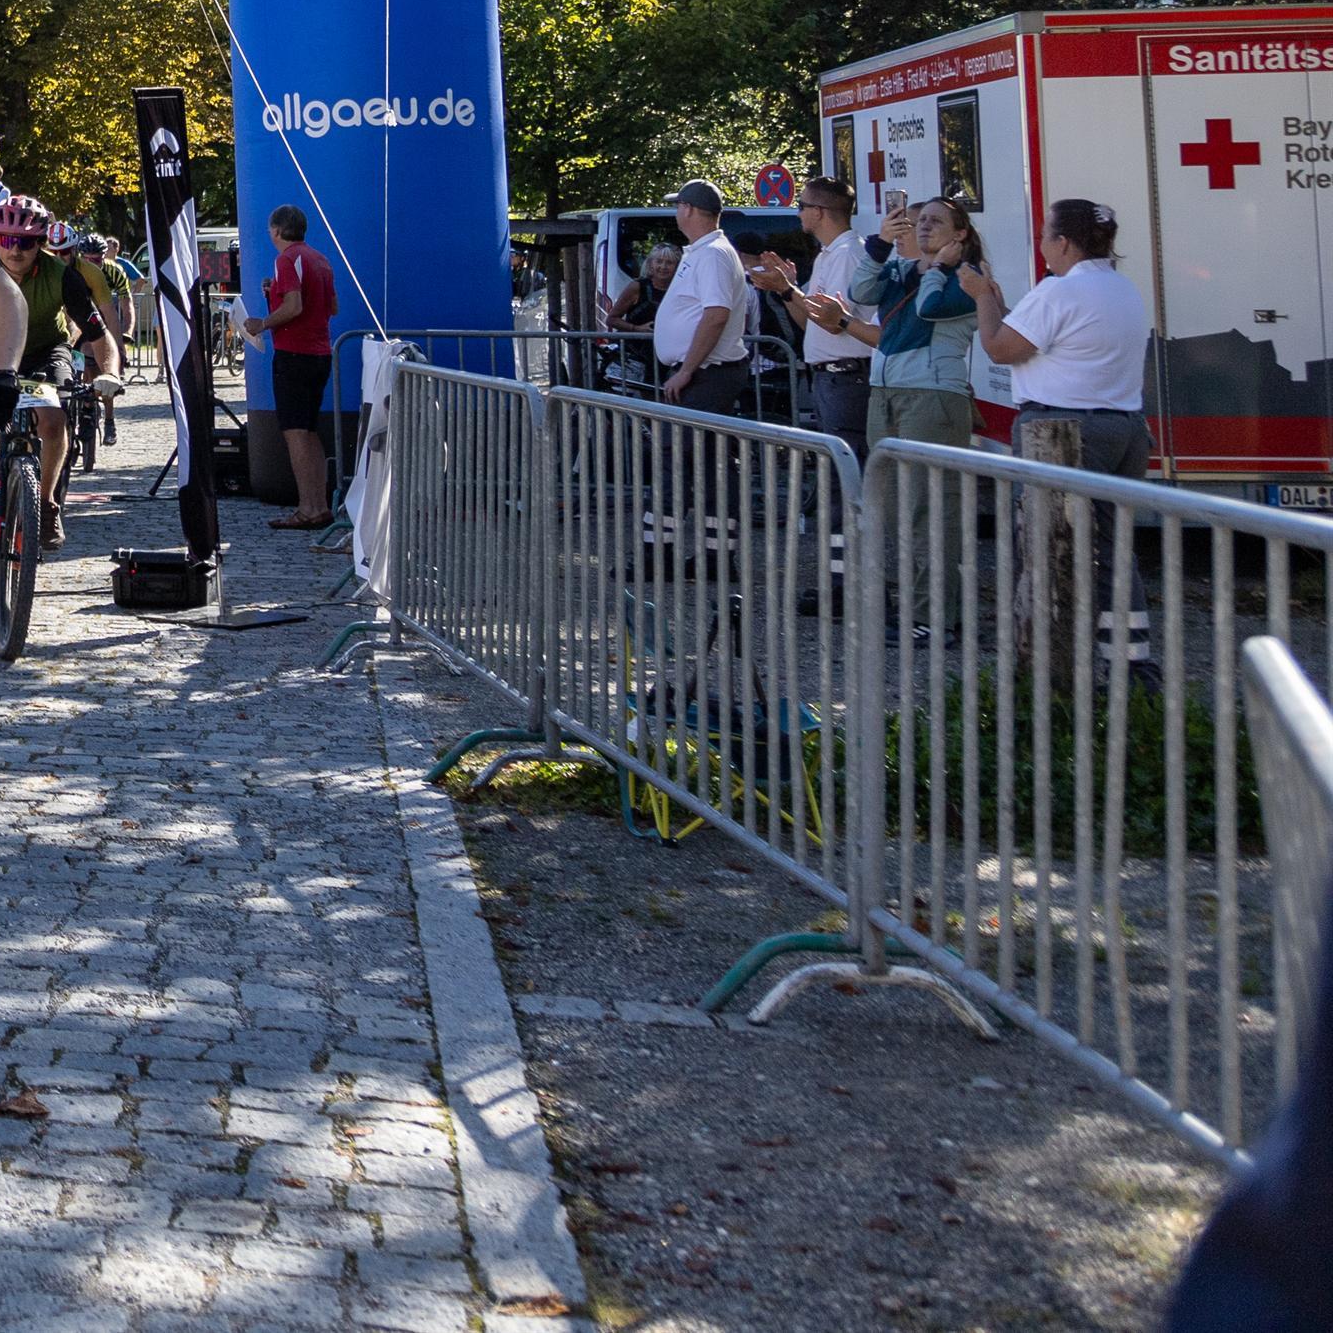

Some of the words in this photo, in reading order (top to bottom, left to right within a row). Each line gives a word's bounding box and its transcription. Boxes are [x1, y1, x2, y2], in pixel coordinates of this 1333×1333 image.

[880, 76, 892, 98] Erste
[892, 72, 905, 94] Hilfe
[907, 67, 919, 91] First
[262, 88, 475, 138] allgaeu.de
[887, 114, 925, 148] Bayerisches
[1285, 143, 1333, 163] Rot
